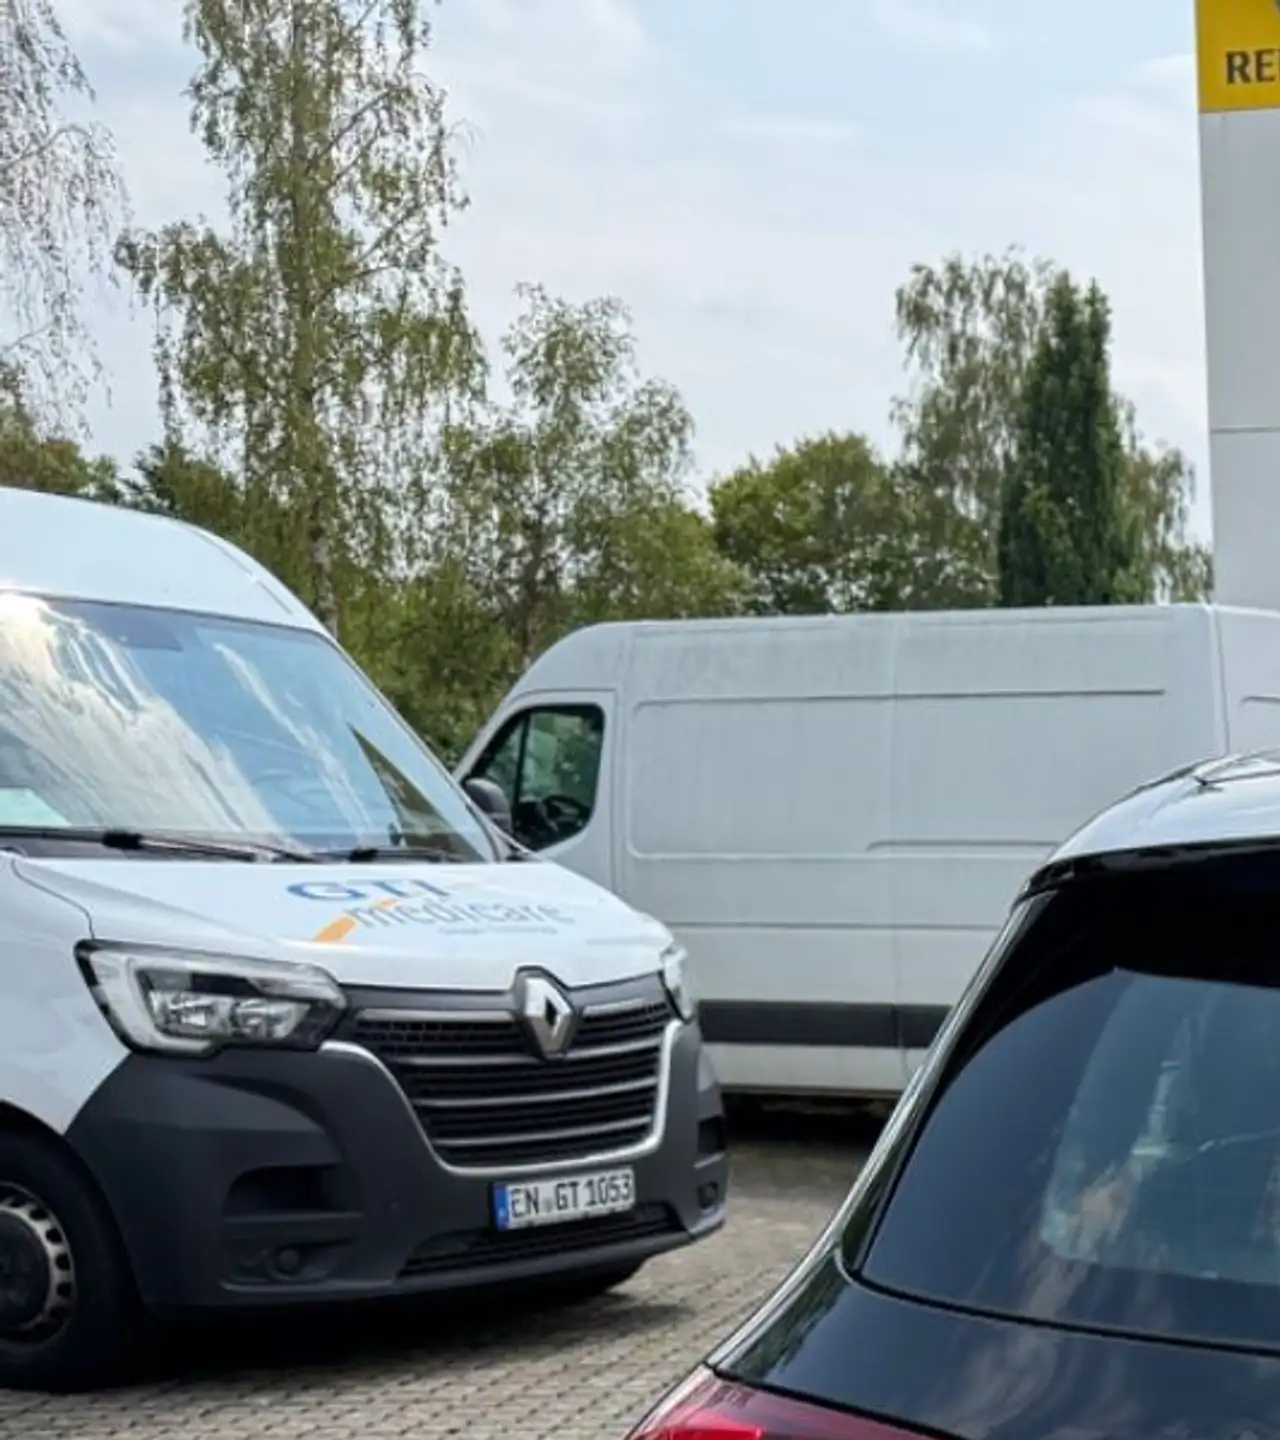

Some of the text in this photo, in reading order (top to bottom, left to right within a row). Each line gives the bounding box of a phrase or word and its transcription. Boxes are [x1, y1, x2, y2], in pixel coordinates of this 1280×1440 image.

[511, 1174, 631, 1218] EN GT 1053
